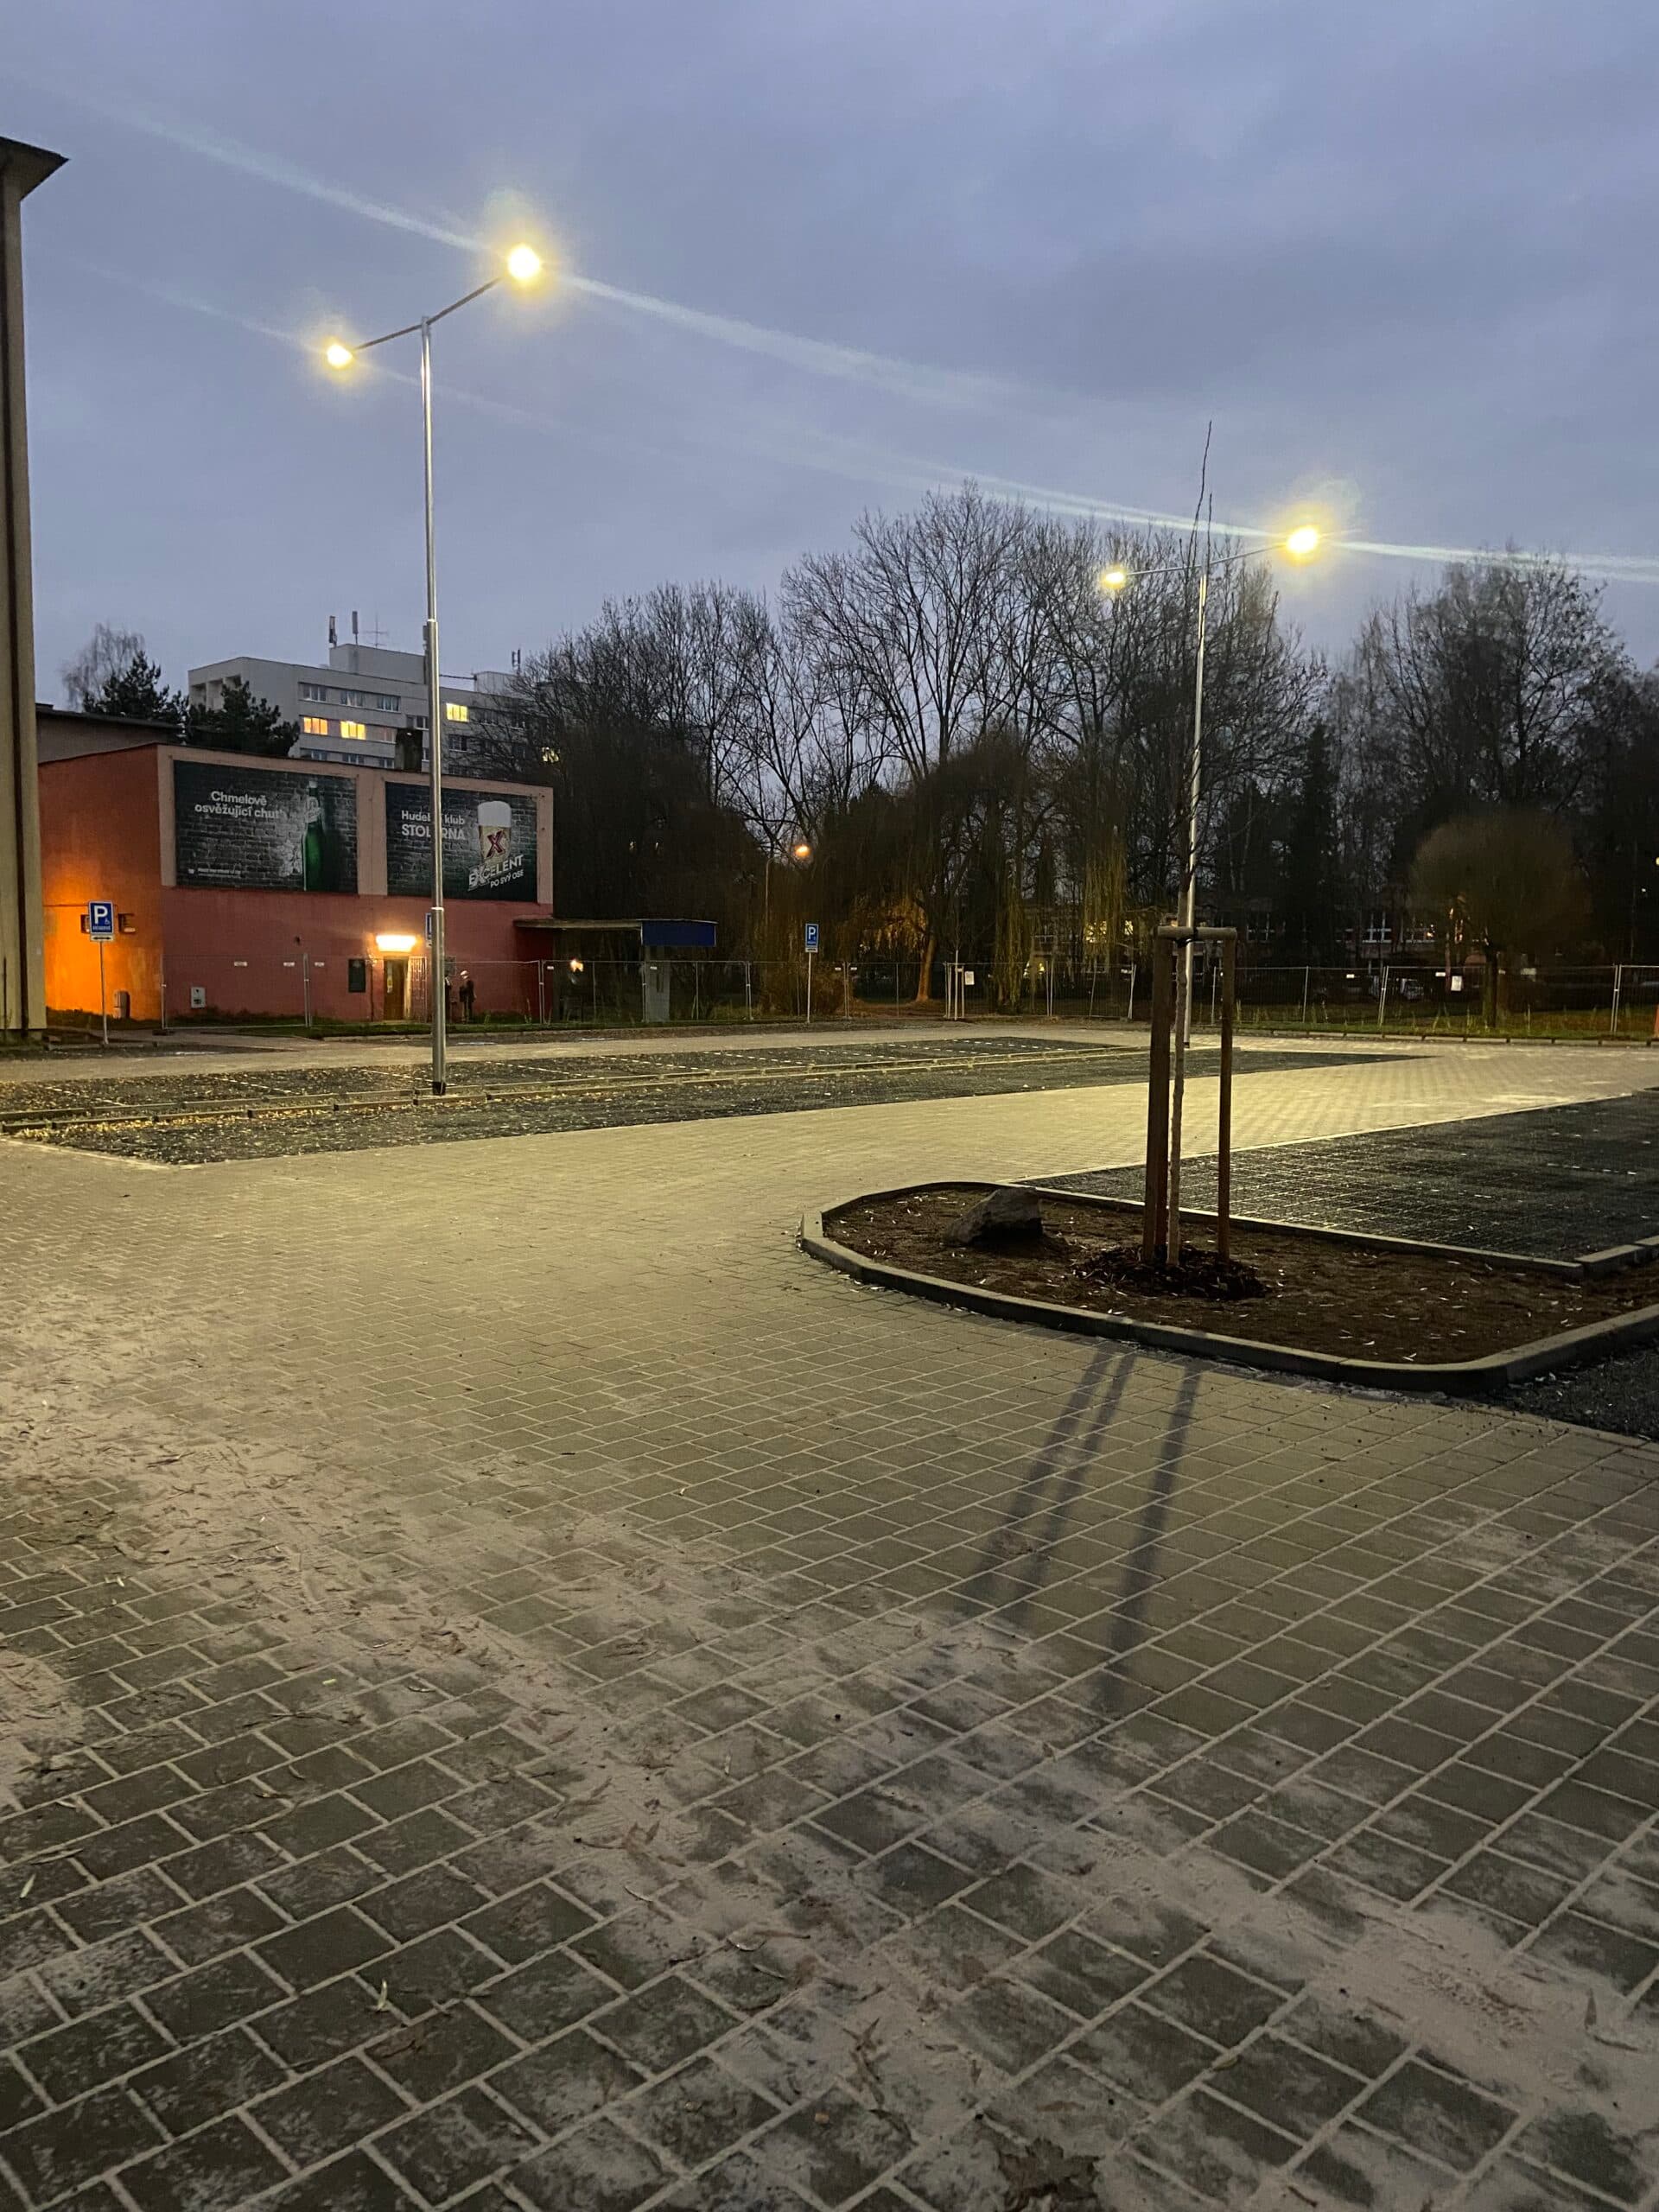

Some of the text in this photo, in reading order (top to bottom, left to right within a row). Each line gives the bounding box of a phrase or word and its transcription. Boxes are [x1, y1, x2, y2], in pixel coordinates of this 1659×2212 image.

[211, 791, 267, 806] Chmelově
[194, 804, 253, 818] osvěžující
[401, 810, 465, 825] Hude klub
[401, 823, 466, 840] STOLRNA
[468, 855, 524, 888] EXCELENT
[490, 879, 499, 888] PO
[93, 905, 108, 925] P
[808, 926, 817, 940] P
